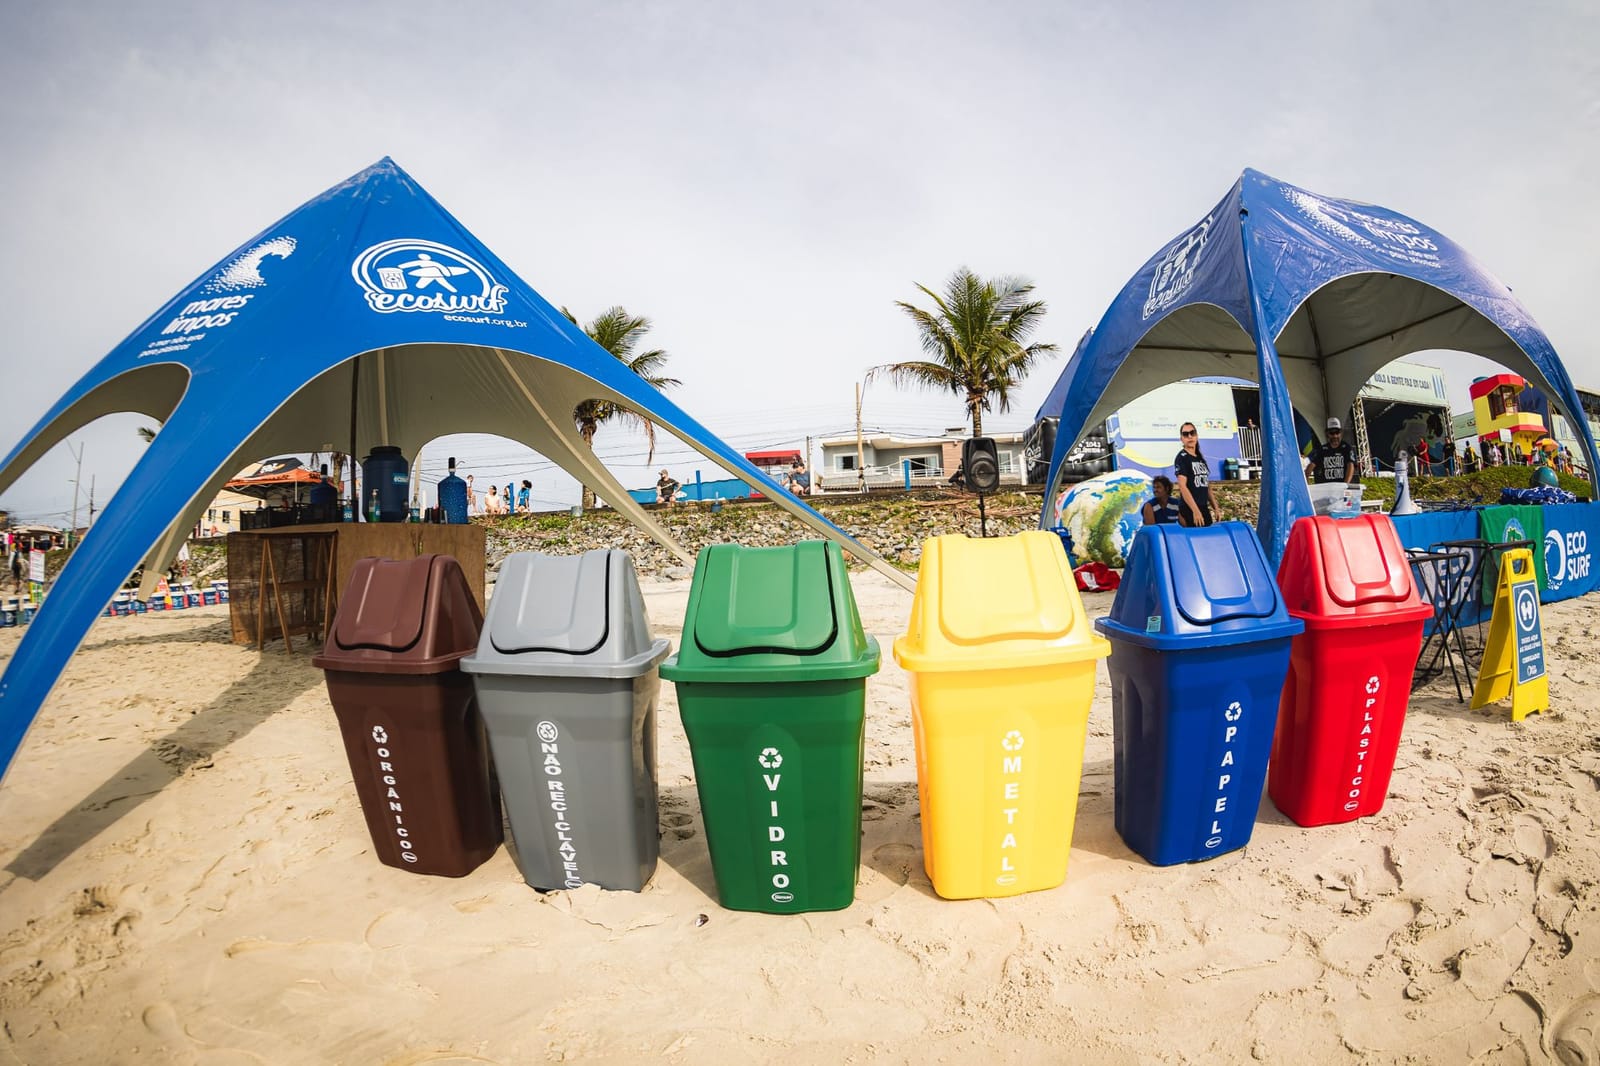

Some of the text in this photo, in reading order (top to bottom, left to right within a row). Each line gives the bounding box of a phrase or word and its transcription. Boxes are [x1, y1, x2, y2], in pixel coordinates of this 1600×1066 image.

[1363, 221, 1438, 251] limpos
[179, 294, 255, 315] mares
[366, 285, 510, 314] ecosurf
[161, 312, 240, 335] limpos
[443, 314, 528, 328] ecosurf.org.br
[1566, 530, 1588, 554] ECO
[1567, 553, 1592, 581] SURF
[541, 743, 563, 776] NÃO
[1211, 726, 1238, 835] PAPEL
[1001, 756, 1022, 872] METAL
[762, 774, 790, 889] VIDRO
